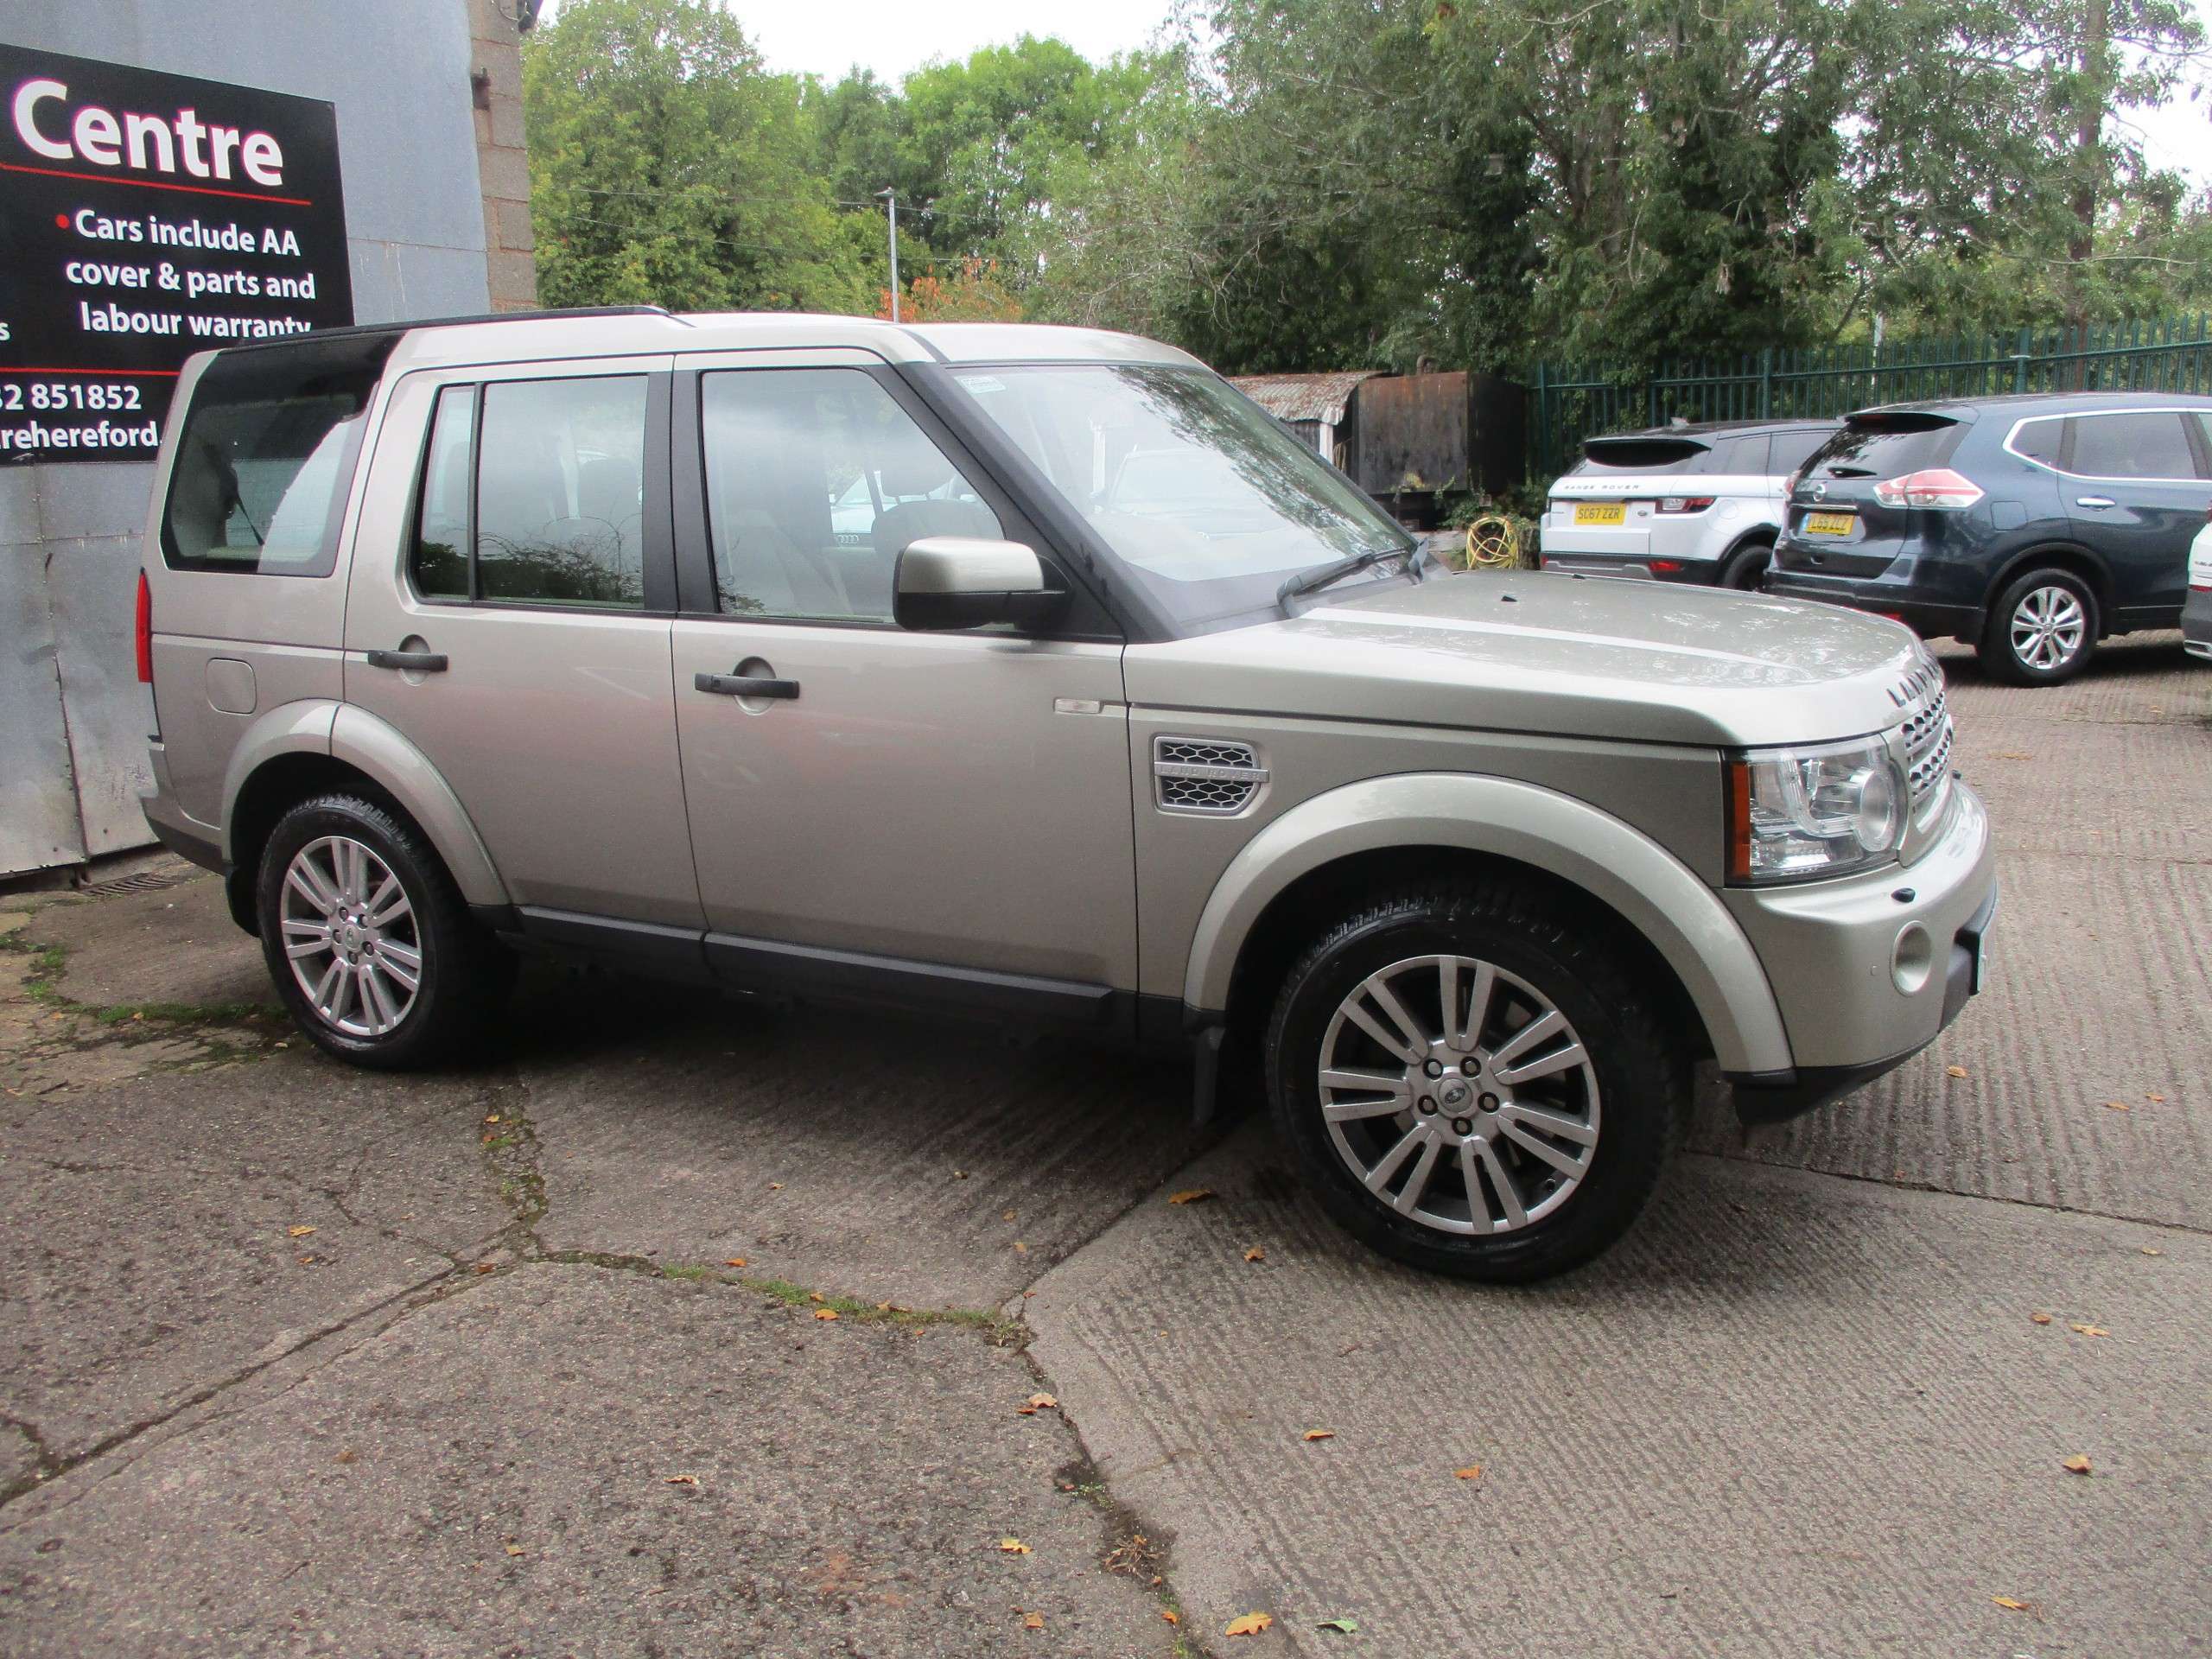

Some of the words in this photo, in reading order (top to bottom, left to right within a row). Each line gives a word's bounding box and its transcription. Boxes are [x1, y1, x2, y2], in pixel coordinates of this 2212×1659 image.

[13, 79, 283, 187] Centre
[75, 209, 143, 243] Cars
[149, 216, 256, 253] include
[262, 228, 301, 257] AA
[66, 262, 150, 289] cover
[158, 263, 181, 291] &
[188, 270, 260, 297] parts
[265, 274, 316, 300] and
[81, 301, 182, 335] labour
[0, 384, 24, 410] 2
[31, 384, 143, 410] 851852
[0, 420, 163, 449] rehereford
